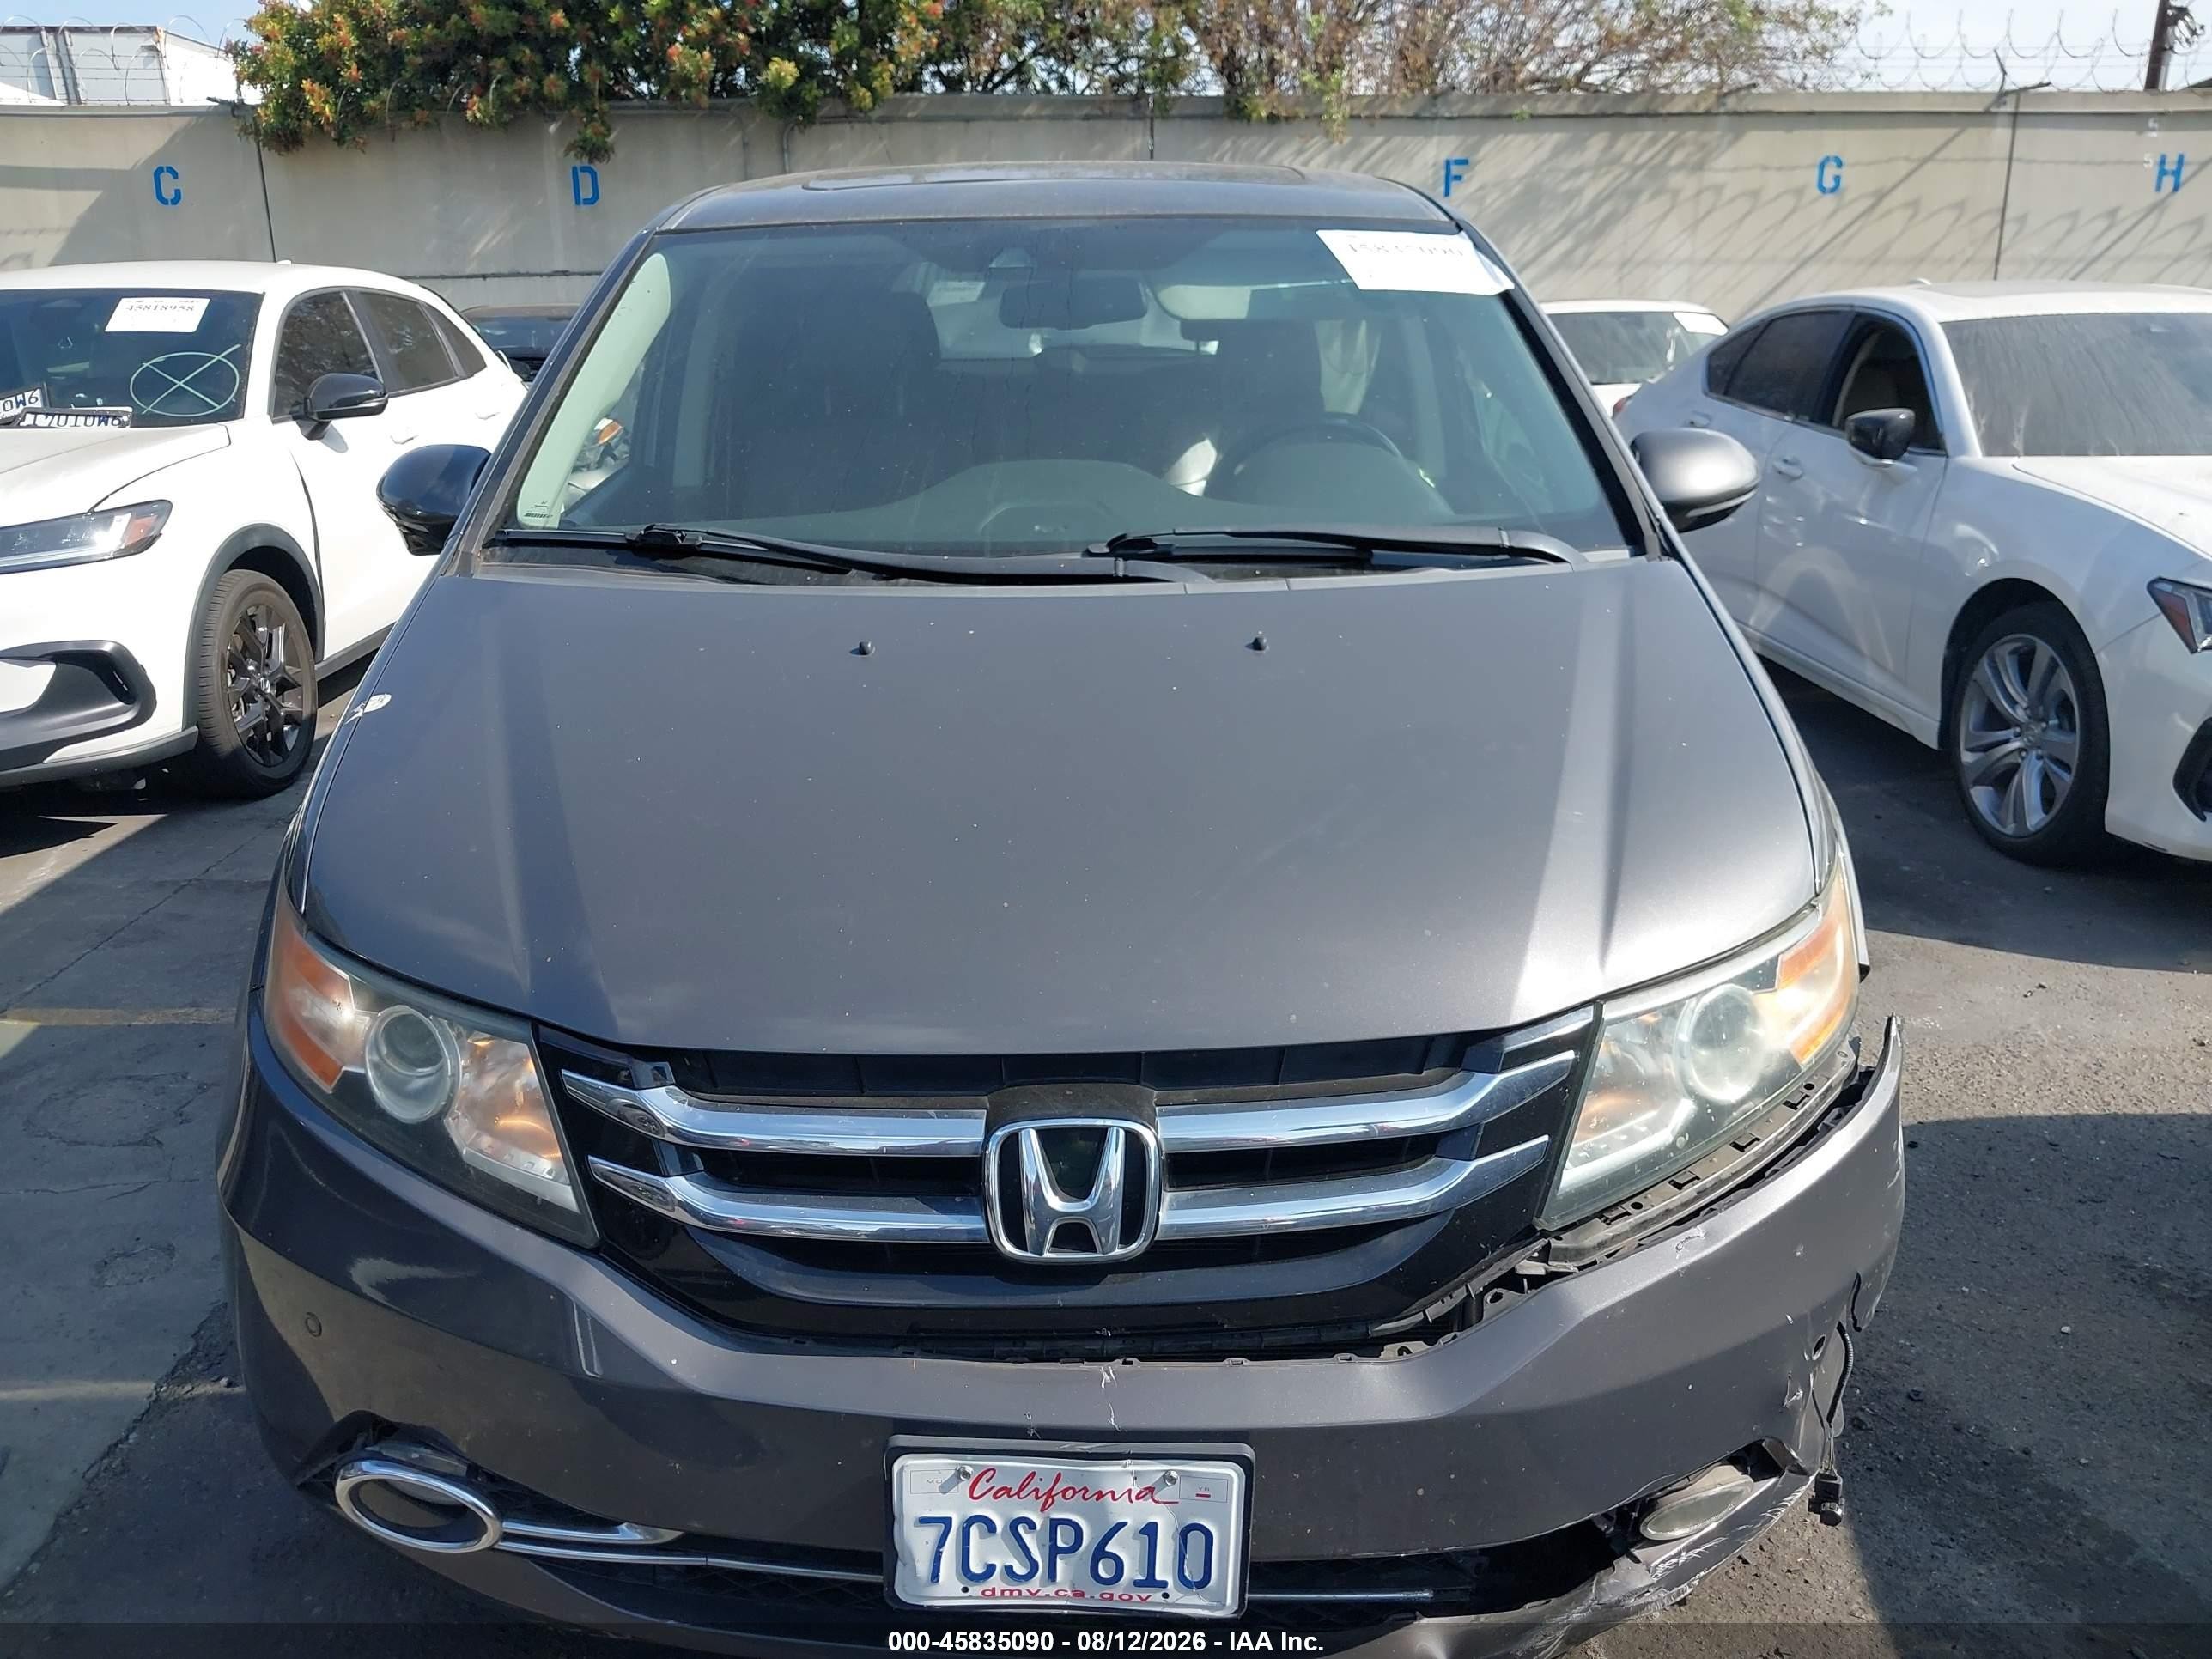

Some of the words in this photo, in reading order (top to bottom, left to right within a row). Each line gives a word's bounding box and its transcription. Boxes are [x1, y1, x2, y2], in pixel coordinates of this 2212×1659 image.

[154, 165, 182, 206] C
[572, 165, 599, 206] D
[1443, 158, 1469, 198] F
[1818, 155, 1844, 194] G
[2154, 153, 2185, 193] H
[968, 1468, 1180, 1513] California
[918, 1514, 1214, 1590] 7CSP610
[981, 1586, 1153, 1603] dmv.ca.gov
